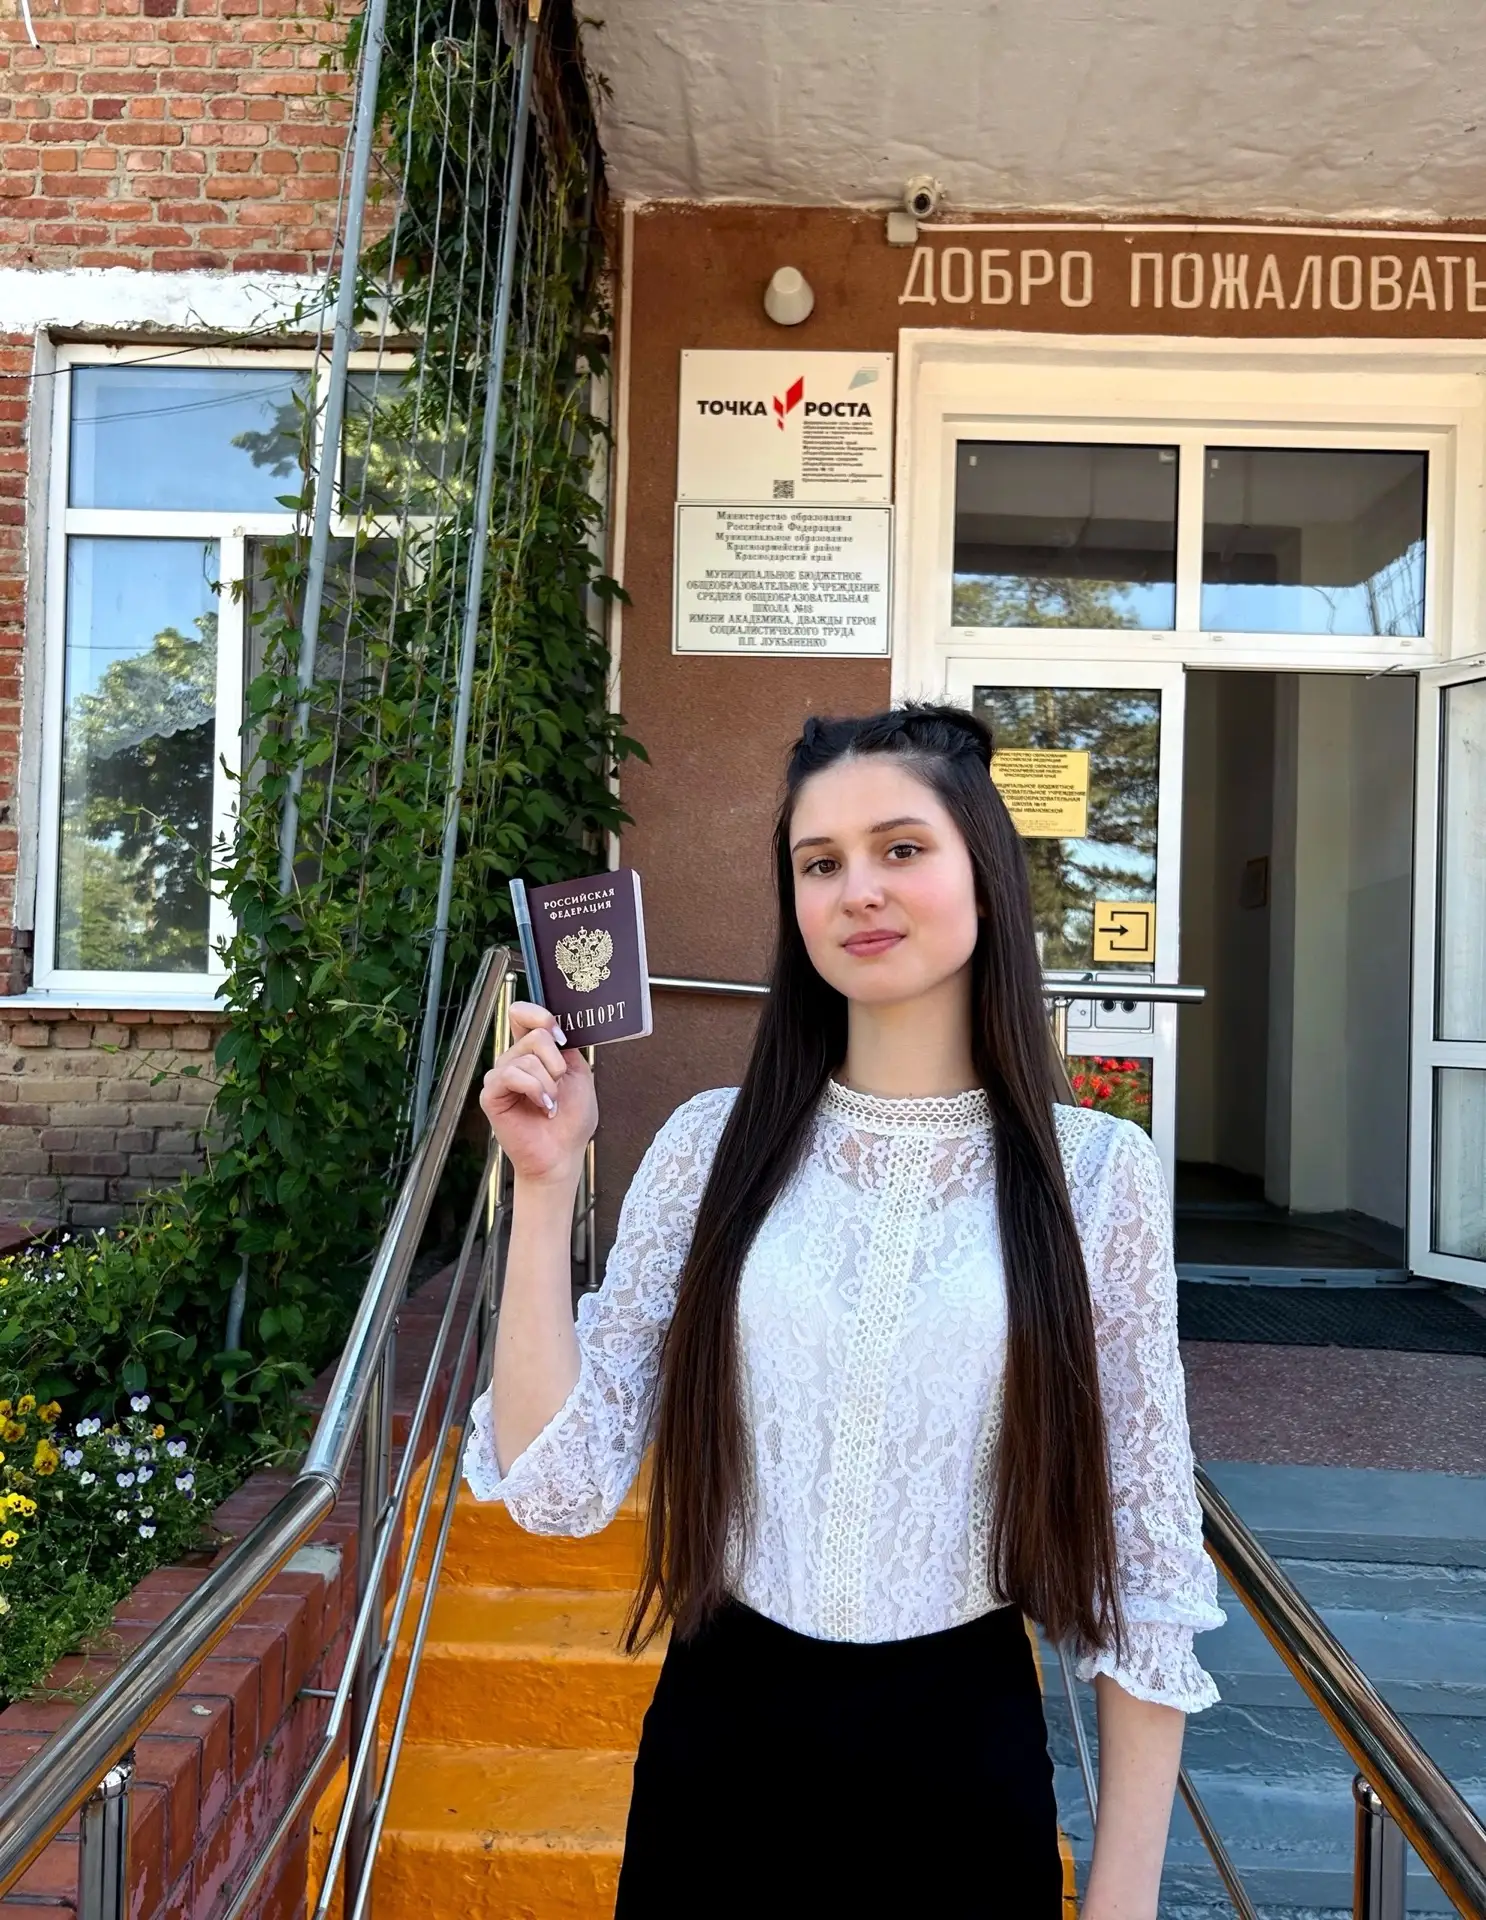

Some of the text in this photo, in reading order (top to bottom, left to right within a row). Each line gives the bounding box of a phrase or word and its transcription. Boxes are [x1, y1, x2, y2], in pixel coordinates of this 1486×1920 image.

[898, 246, 1486, 313] ДОБРО ПОЖАЛОВАТЬ
[697, 400, 872, 417] ТОЧКА РОСТА
[716, 511, 788, 522] Министерство
[726, 521, 842, 534] Российской Федерации
[715, 532, 792, 543] Муниципальное
[726, 541, 842, 553] Красноармейский район
[735, 551, 833, 563] Краснодарский край
[705, 570, 862, 582] МУНИЦИПАЛЬНОЕ БЮДЖЕТНОЕ
[686, 580, 881, 593] ОБЩЕОБРАЗОВАТЕЛЬНОЕ УЧРЕЖДЕНИЕ
[696, 592, 869, 604] СРЕДНЯЯ ОБЩЕОБРАЗОВАТЕЛЬНАЯ
[752, 603, 790, 613] ШКОЛА
[689, 613, 725, 623] ИМЕНИ
[796, 615, 844, 627] ДВАЖДЫ
[846, 616, 877, 626] ГЕРОЯ
[709, 625, 855, 639] СОЦИАЛИСТИЧЕСКОГО ТРУДА
[759, 637, 828, 648] ЛУКЬЯНЕНКО
[543, 888, 616, 910] РОССИЙСКАЯ
[549, 900, 612, 920] ФЕДЕРАЦИЯ
